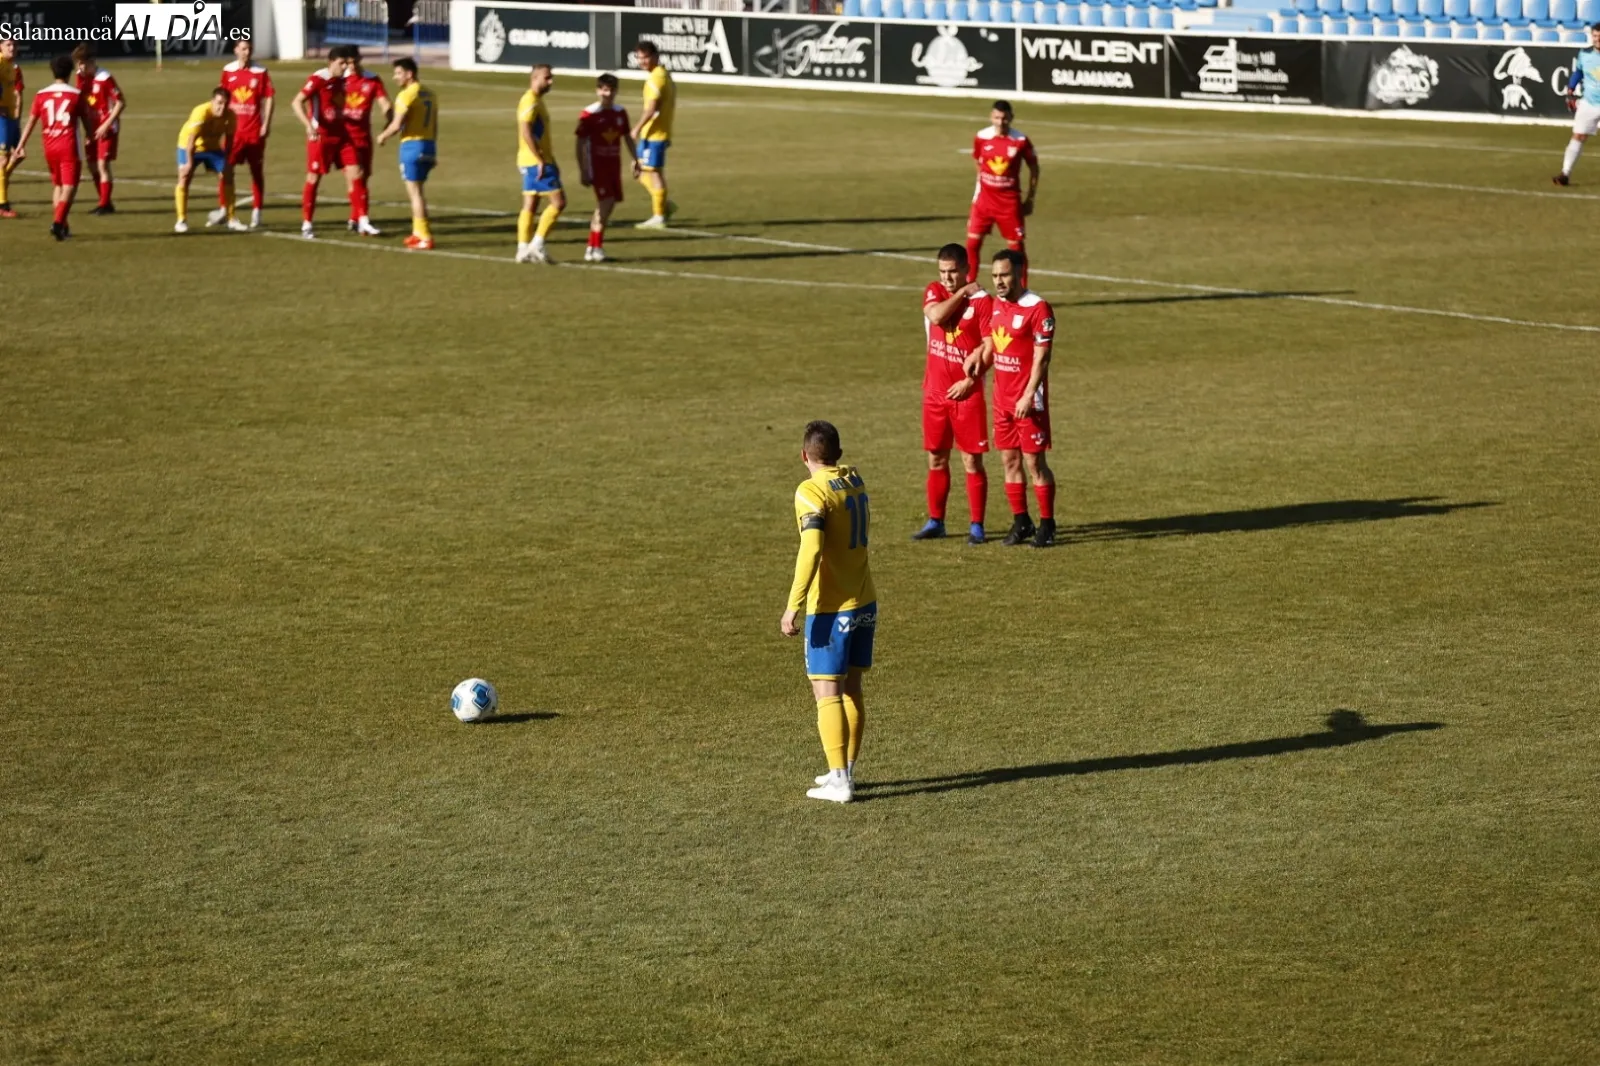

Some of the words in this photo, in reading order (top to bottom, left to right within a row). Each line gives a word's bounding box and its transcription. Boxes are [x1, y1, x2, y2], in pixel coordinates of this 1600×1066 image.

[1022, 36, 1164, 65] VITALDENT
[1051, 68, 1135, 89] SALAMANCA
[42, 99, 71, 127] 14
[845, 493, 869, 549] 10
